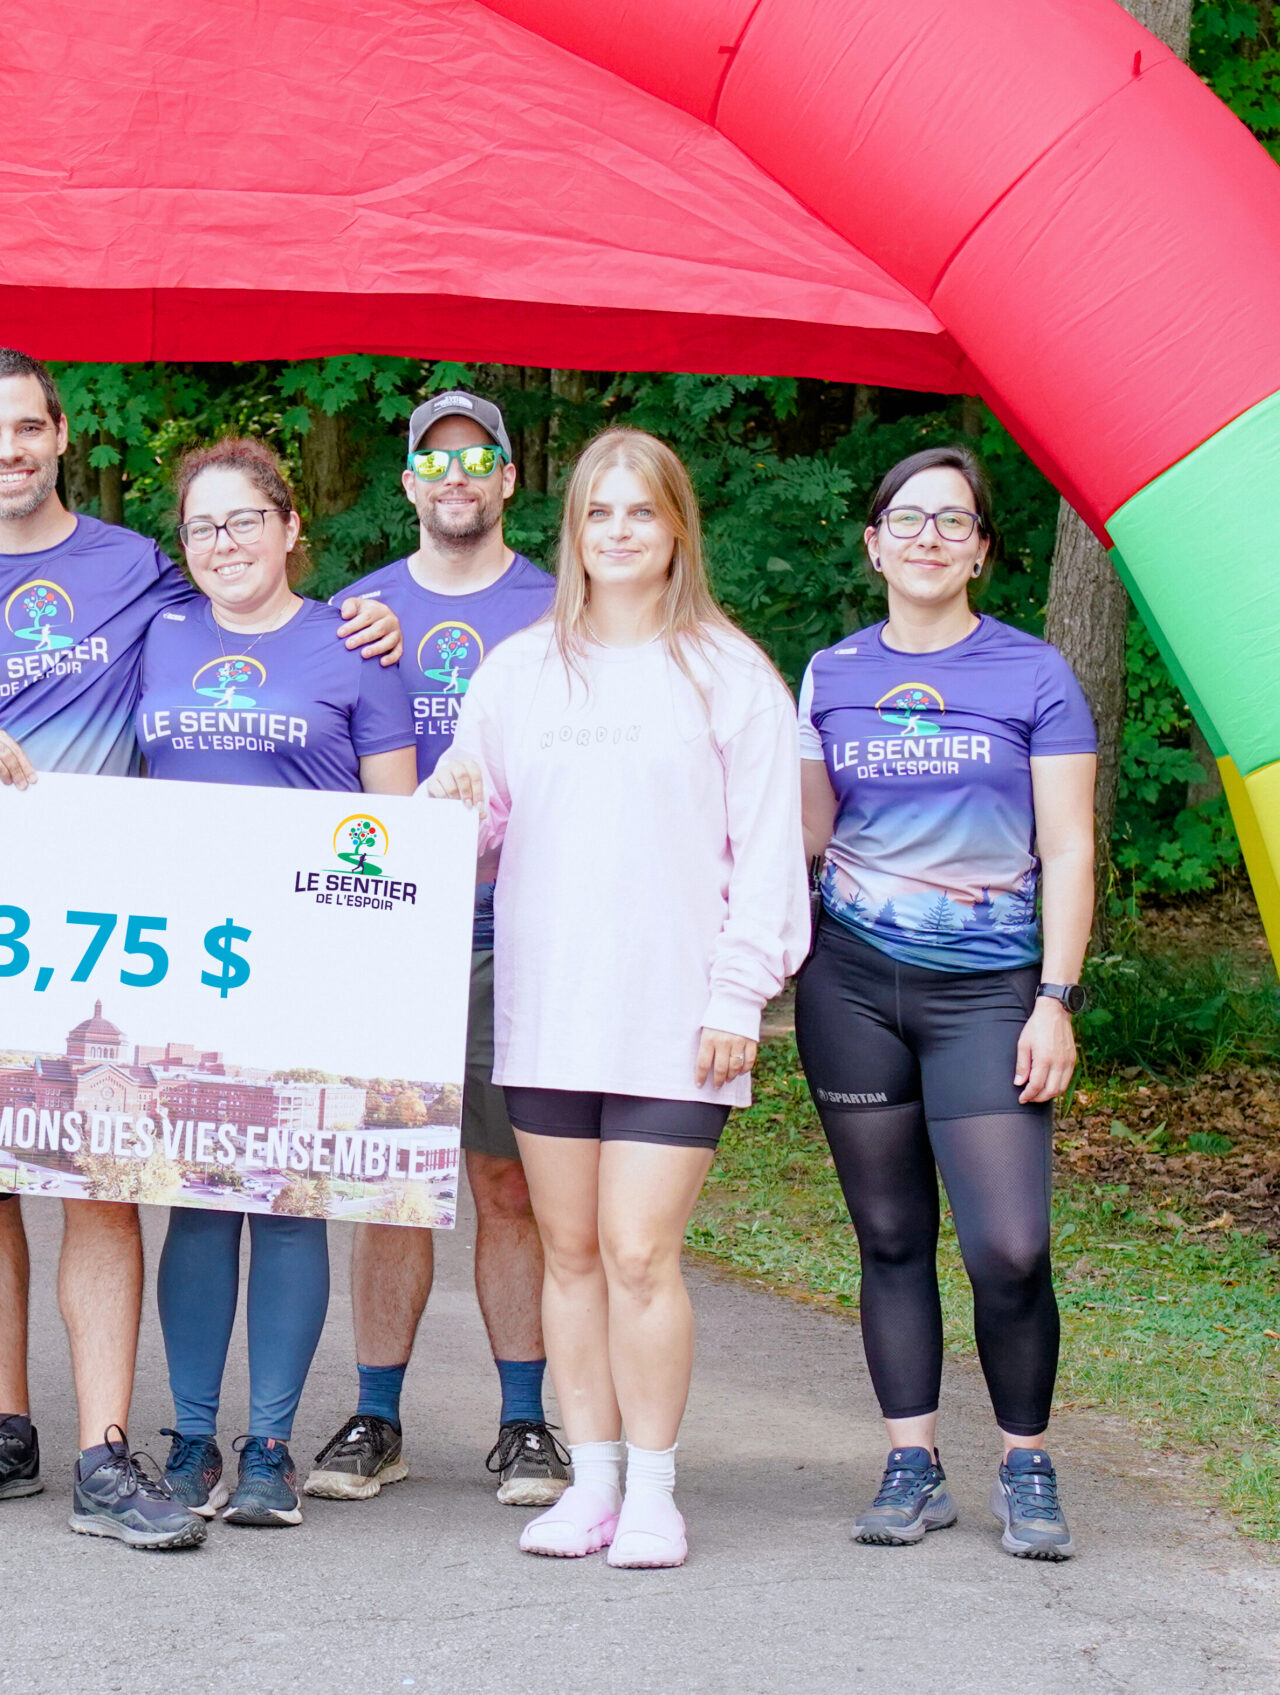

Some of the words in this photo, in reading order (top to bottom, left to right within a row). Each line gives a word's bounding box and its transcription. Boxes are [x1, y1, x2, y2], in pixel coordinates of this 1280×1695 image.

[6, 637, 108, 679] SENER
[143, 710, 171, 743] LE
[179, 711, 308, 748] SENTIER
[172, 735, 195, 750] DE
[199, 735, 275, 753] L'ESPOIR
[833, 741, 860, 772] LE
[867, 735, 991, 764] SENTIER
[857, 765, 879, 780] DE
[883, 760, 959, 777] L'ESPOIR
[295, 871, 320, 893] LE
[325, 874, 417, 905] SENTIER
[316, 893, 333, 905] DE
[336, 894, 393, 911] L'ESPOIR
[200, 918, 252, 999] $
[828, 1091, 888, 1104] SPARTAN
[90, 1112, 155, 1158] DES
[162, 1119, 238, 1167] VIES
[245, 1123, 428, 1180] ENSEMBLE
